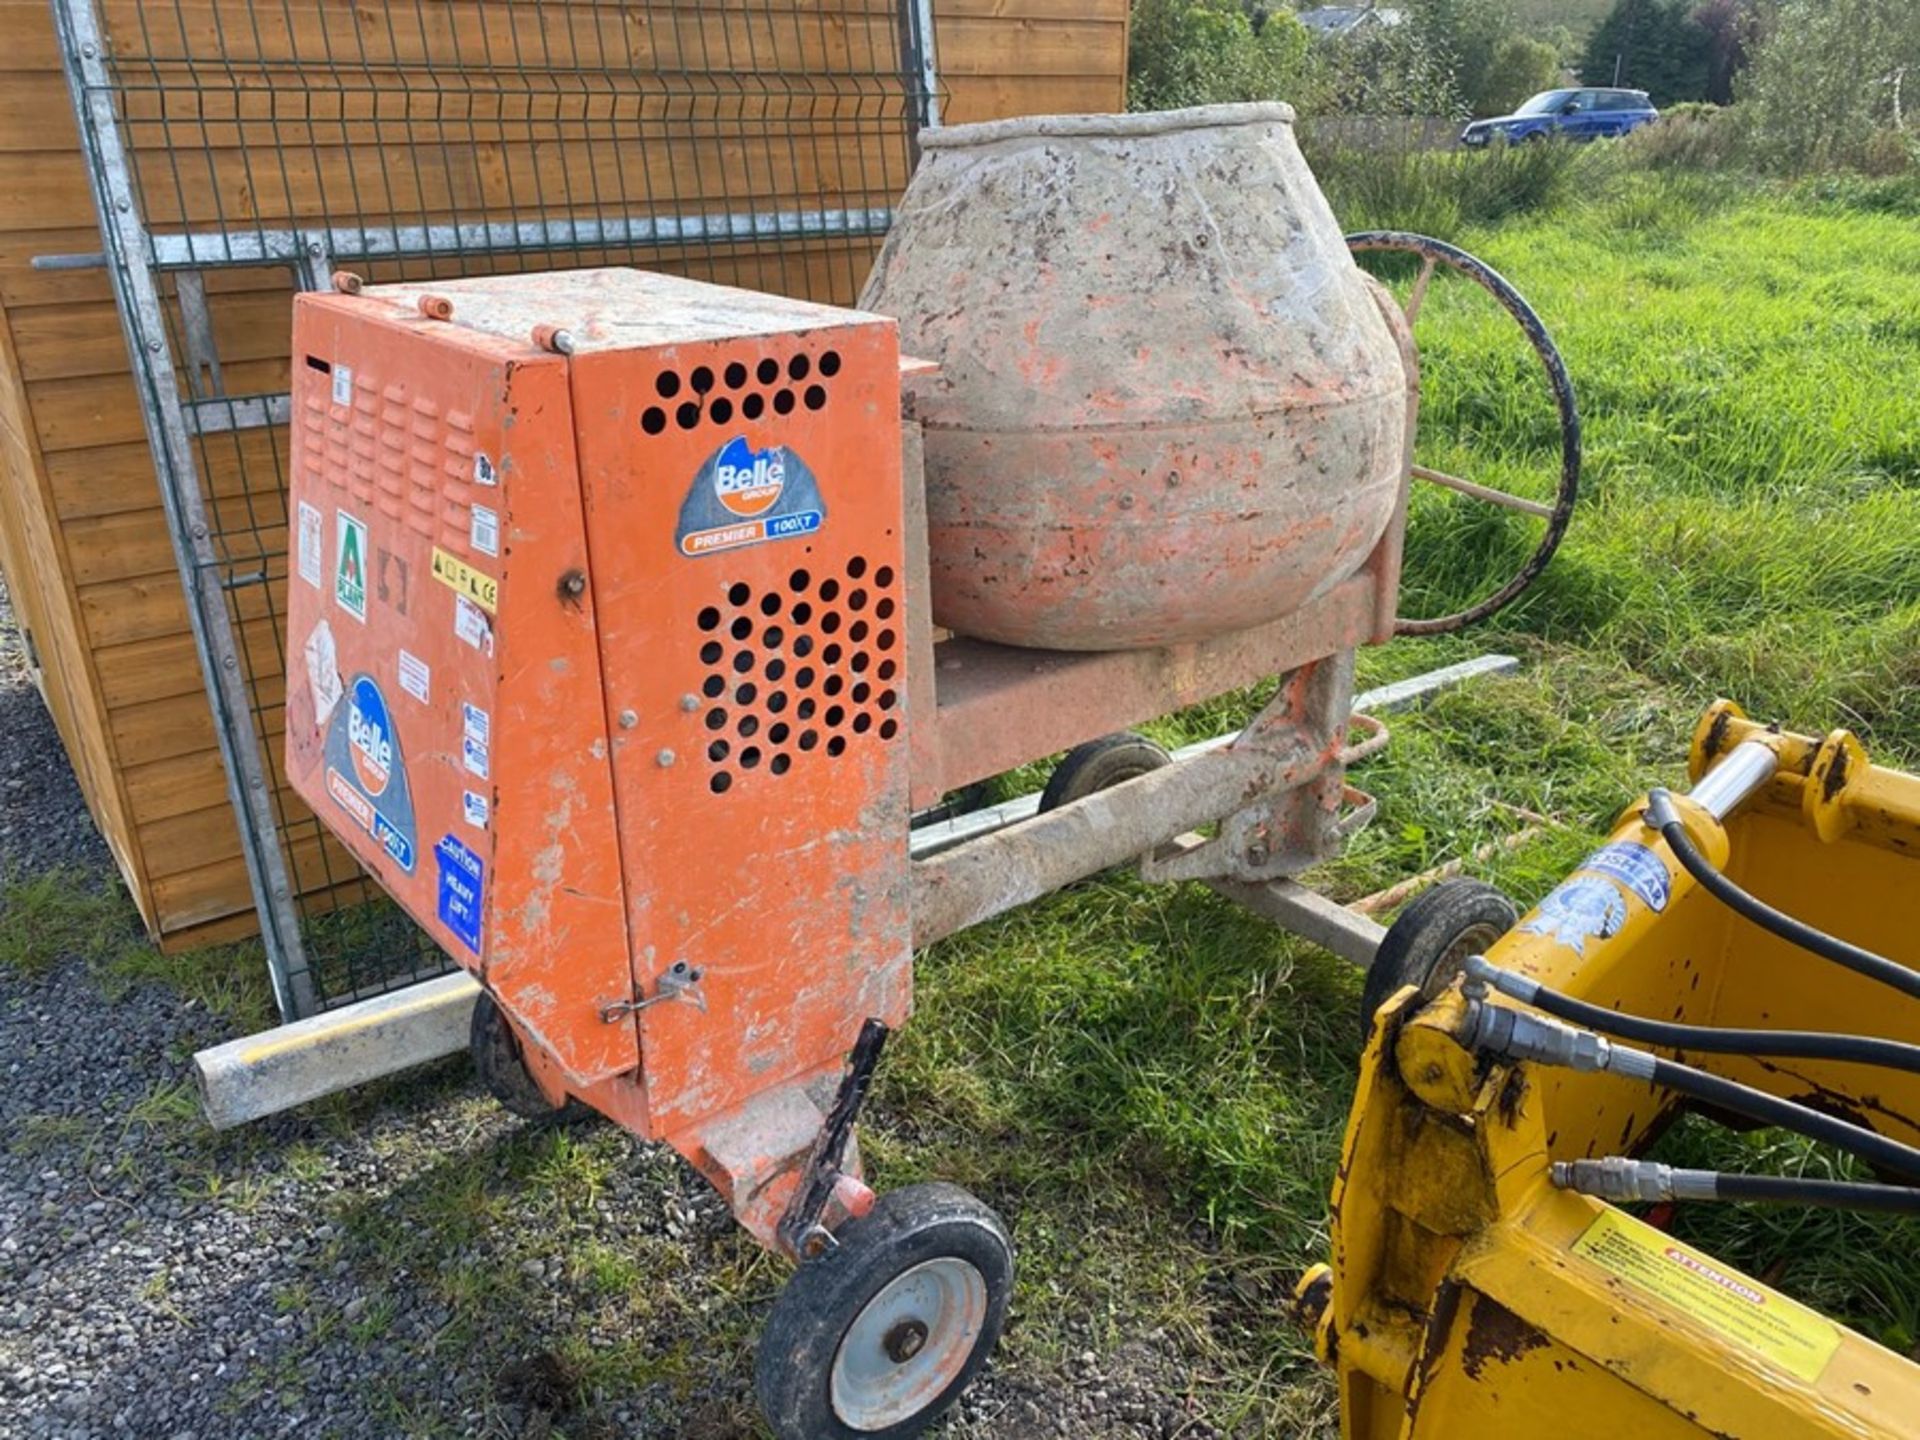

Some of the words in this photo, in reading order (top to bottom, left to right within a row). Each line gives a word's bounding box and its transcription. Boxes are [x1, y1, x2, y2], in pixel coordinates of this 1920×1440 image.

[717, 459, 785, 491] Belle
[693, 527, 756, 549] PREMIER
[774, 515, 812, 532] 100XT
[348, 704, 391, 772] Belle
[439, 836, 481, 878] CAUTION
[446, 871, 474, 904] HEAVY
[449, 895, 469, 920] LIFT
[1669, 1250, 1762, 1303] ATTENTION
